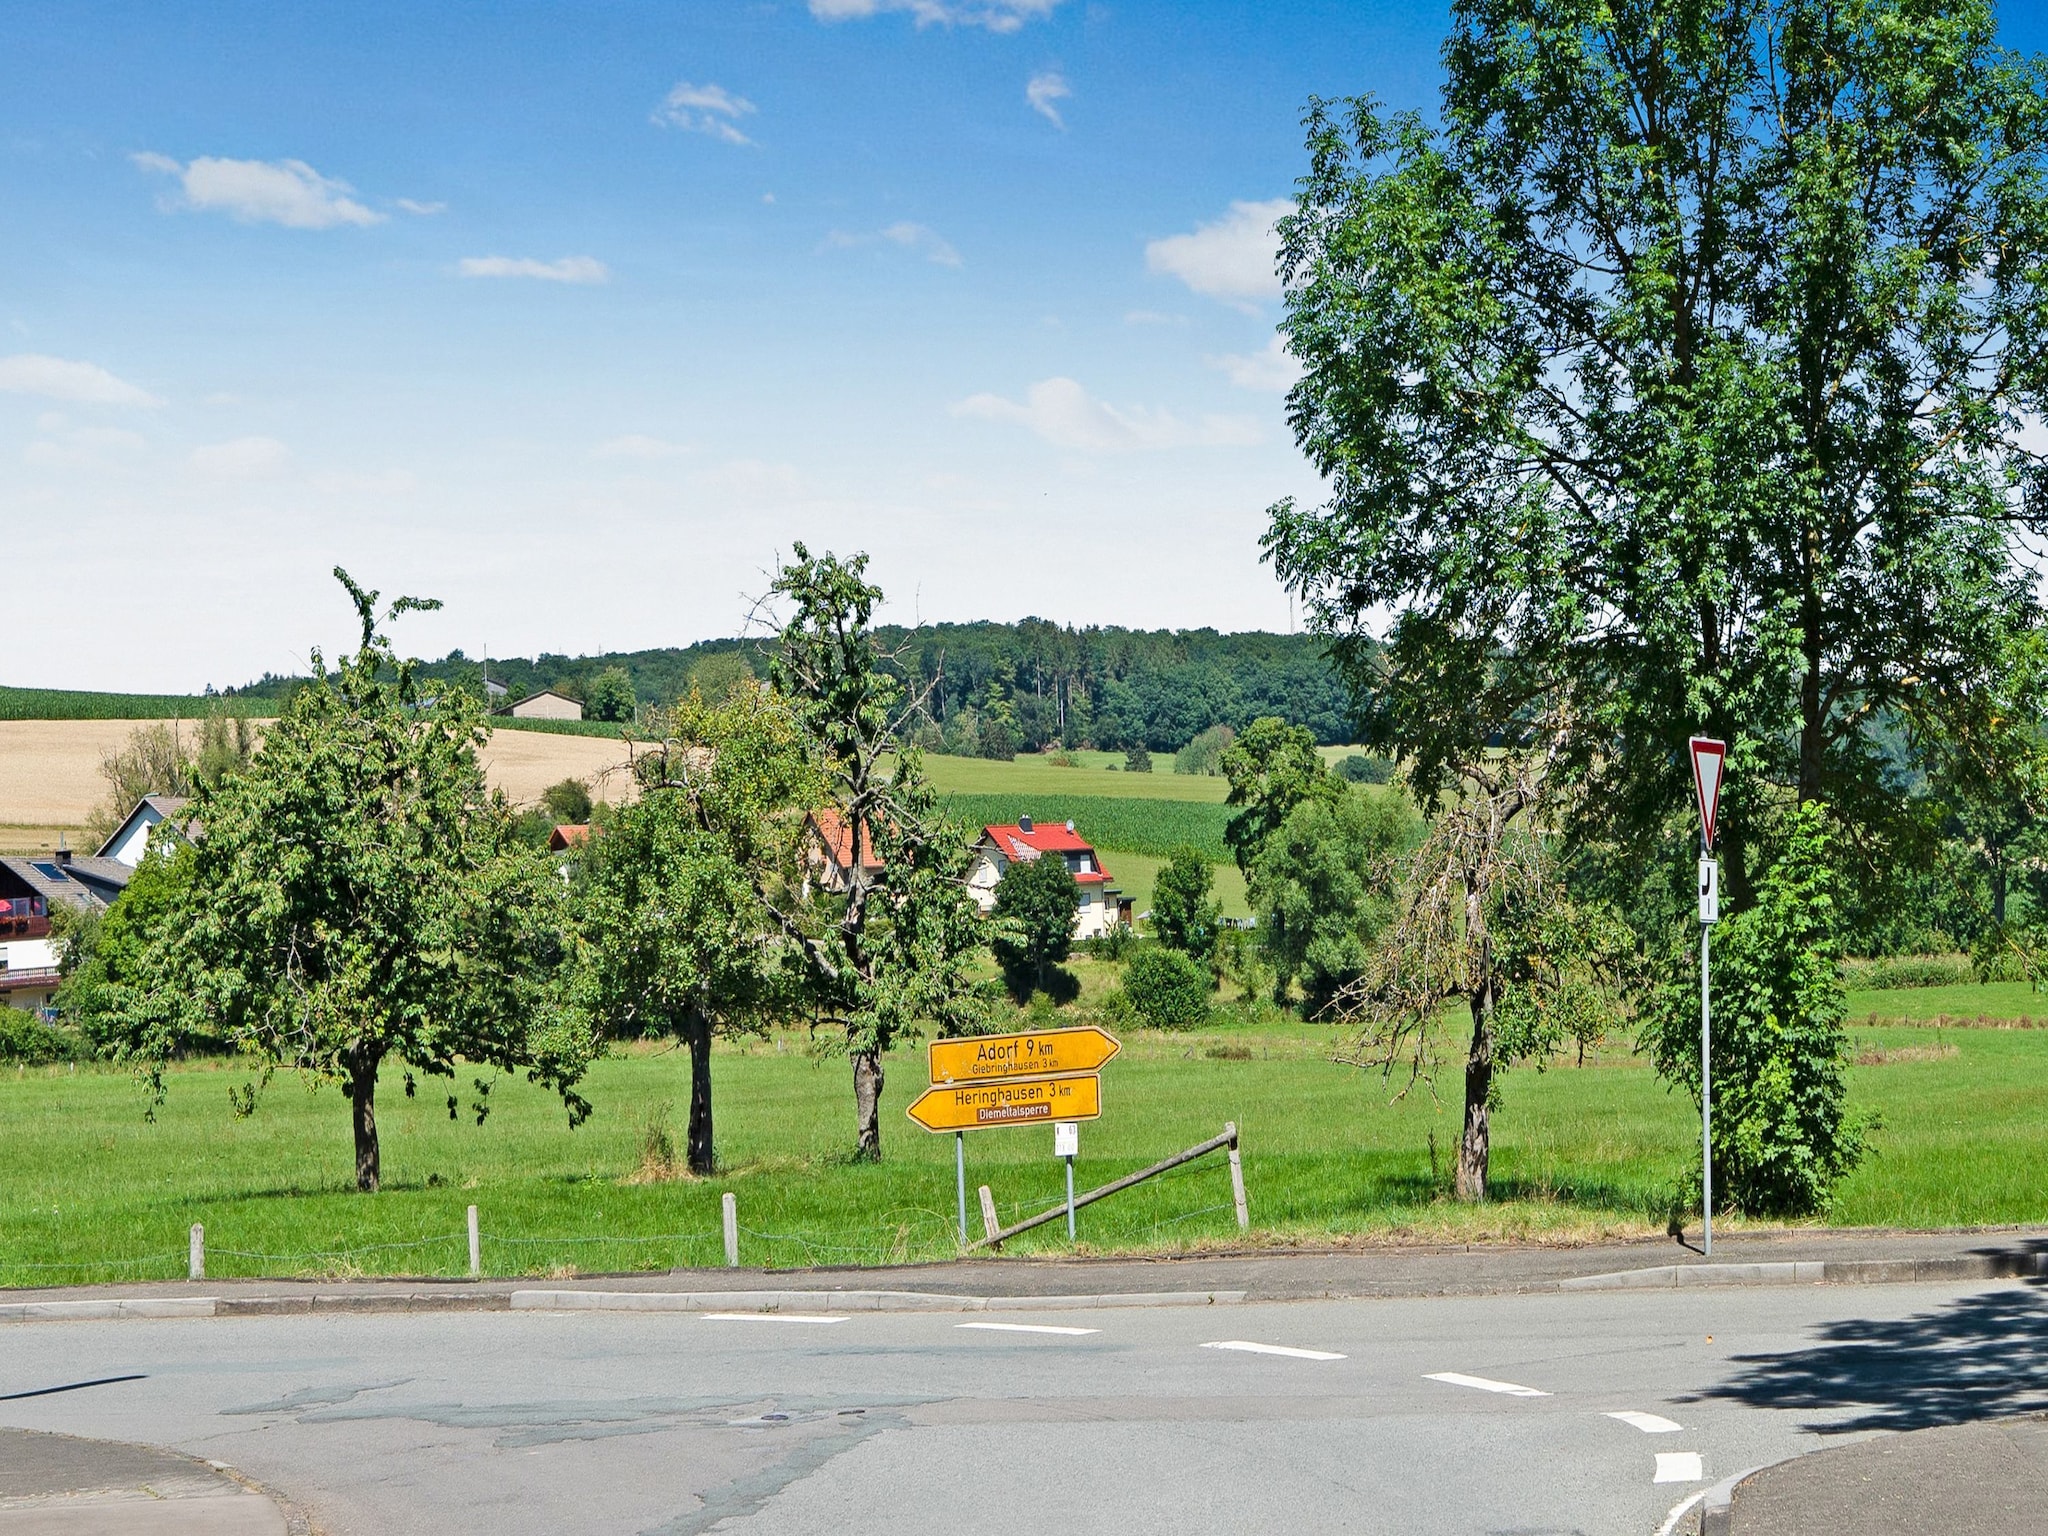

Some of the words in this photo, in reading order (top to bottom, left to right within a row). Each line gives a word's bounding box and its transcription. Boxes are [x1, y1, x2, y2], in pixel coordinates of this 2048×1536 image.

[977, 1040, 1019, 1061] Adorf
[1026, 1039, 1034, 1056] 9
[1038, 1041, 1053, 1056] km
[972, 1060, 1039, 1075] Giebringhausen
[1042, 1058, 1048, 1068] 3
[1049, 1059, 1058, 1068] km
[955, 1086, 1043, 1107] Heringhausen
[1049, 1082, 1056, 1098] 3
[1059, 1084, 1071, 1096] km
[979, 1104, 1048, 1120] Diemeltalsperre
